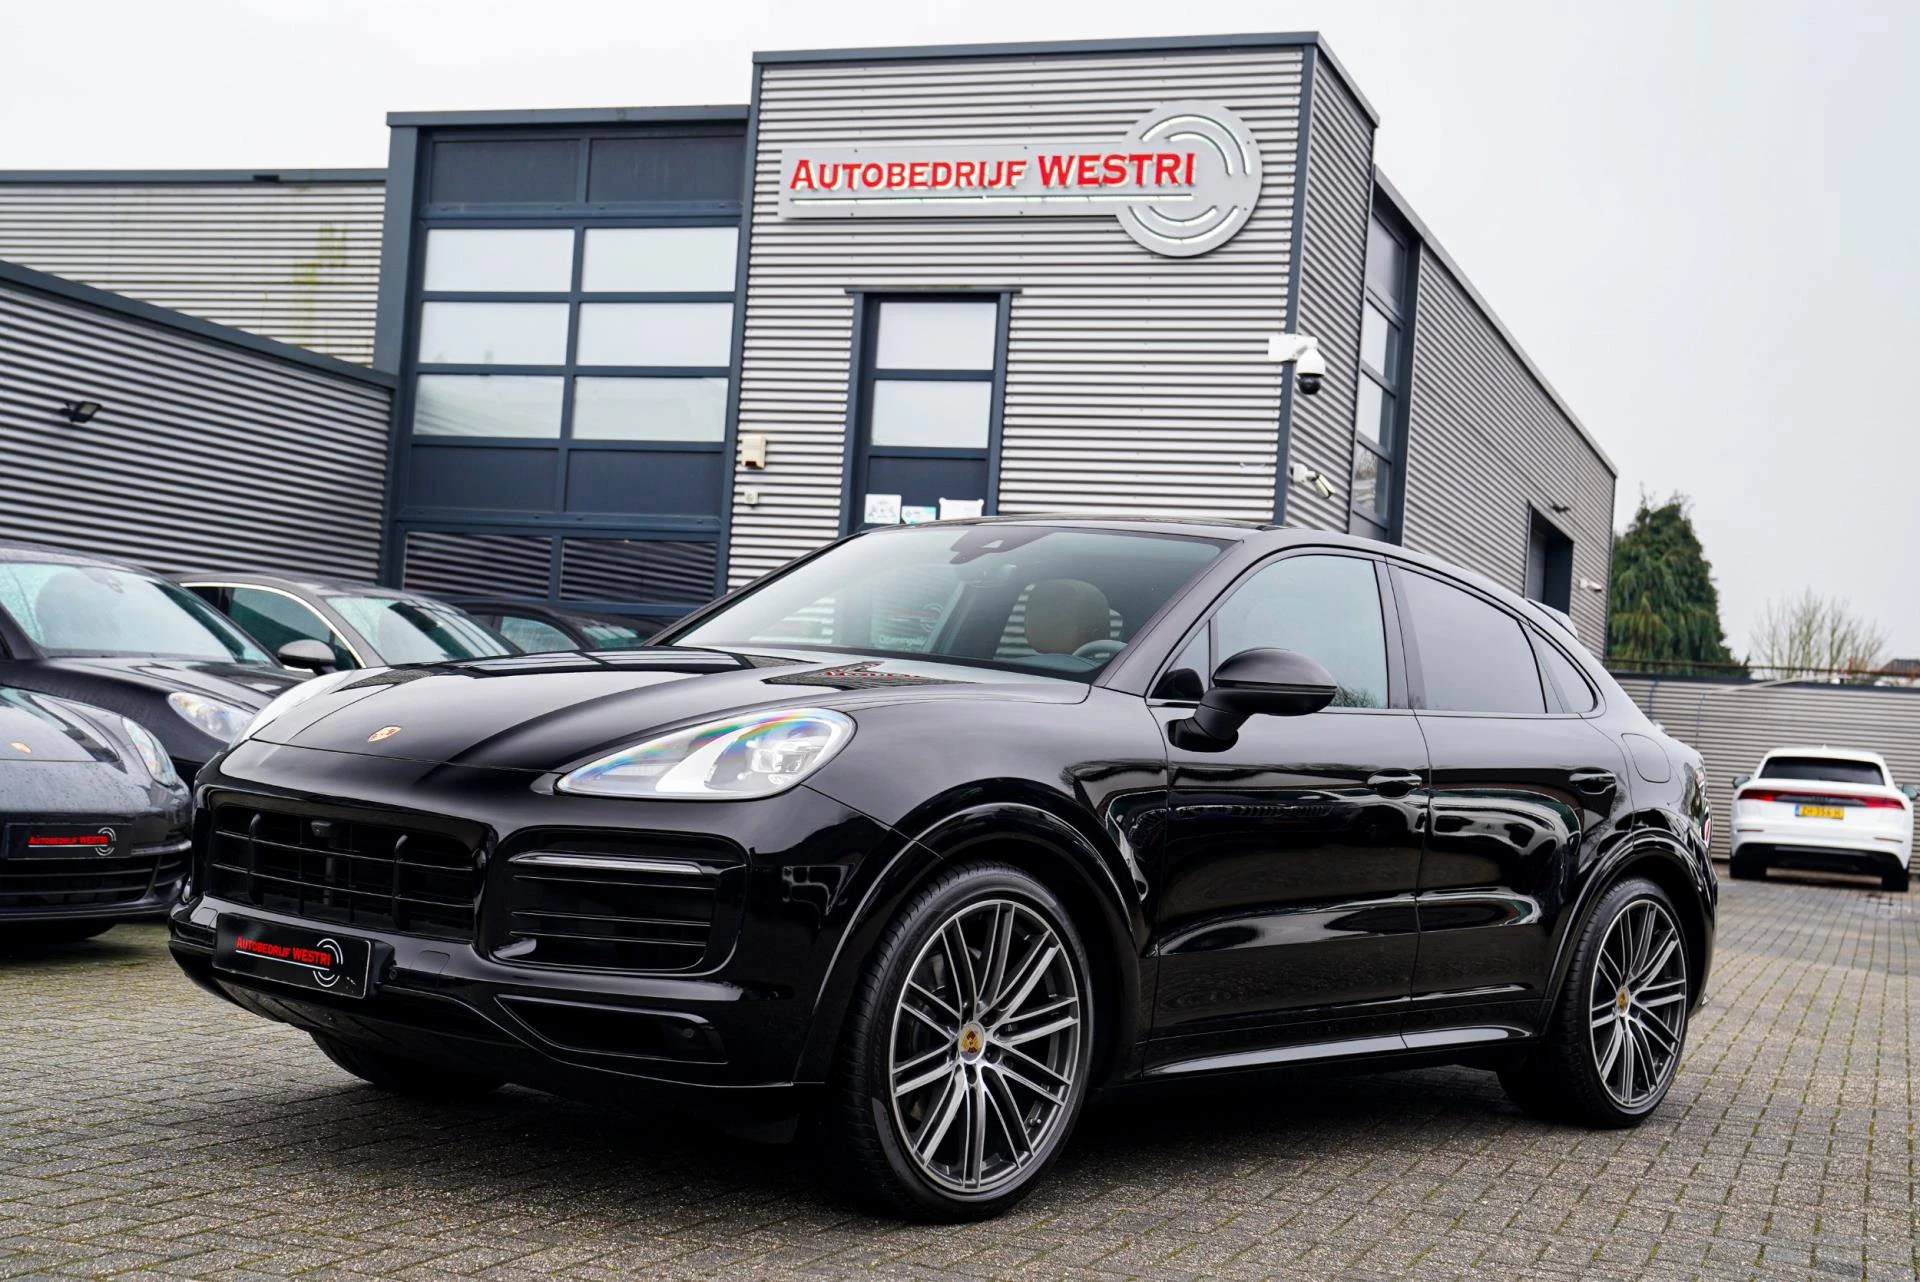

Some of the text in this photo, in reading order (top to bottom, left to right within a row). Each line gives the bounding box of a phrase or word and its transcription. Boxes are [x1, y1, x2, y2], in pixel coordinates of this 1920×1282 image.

[789, 151, 1196, 190] AUTOBEDRIJF WESTRI
[235, 935, 332, 966] AUTOBEDRIJF WESTRI
